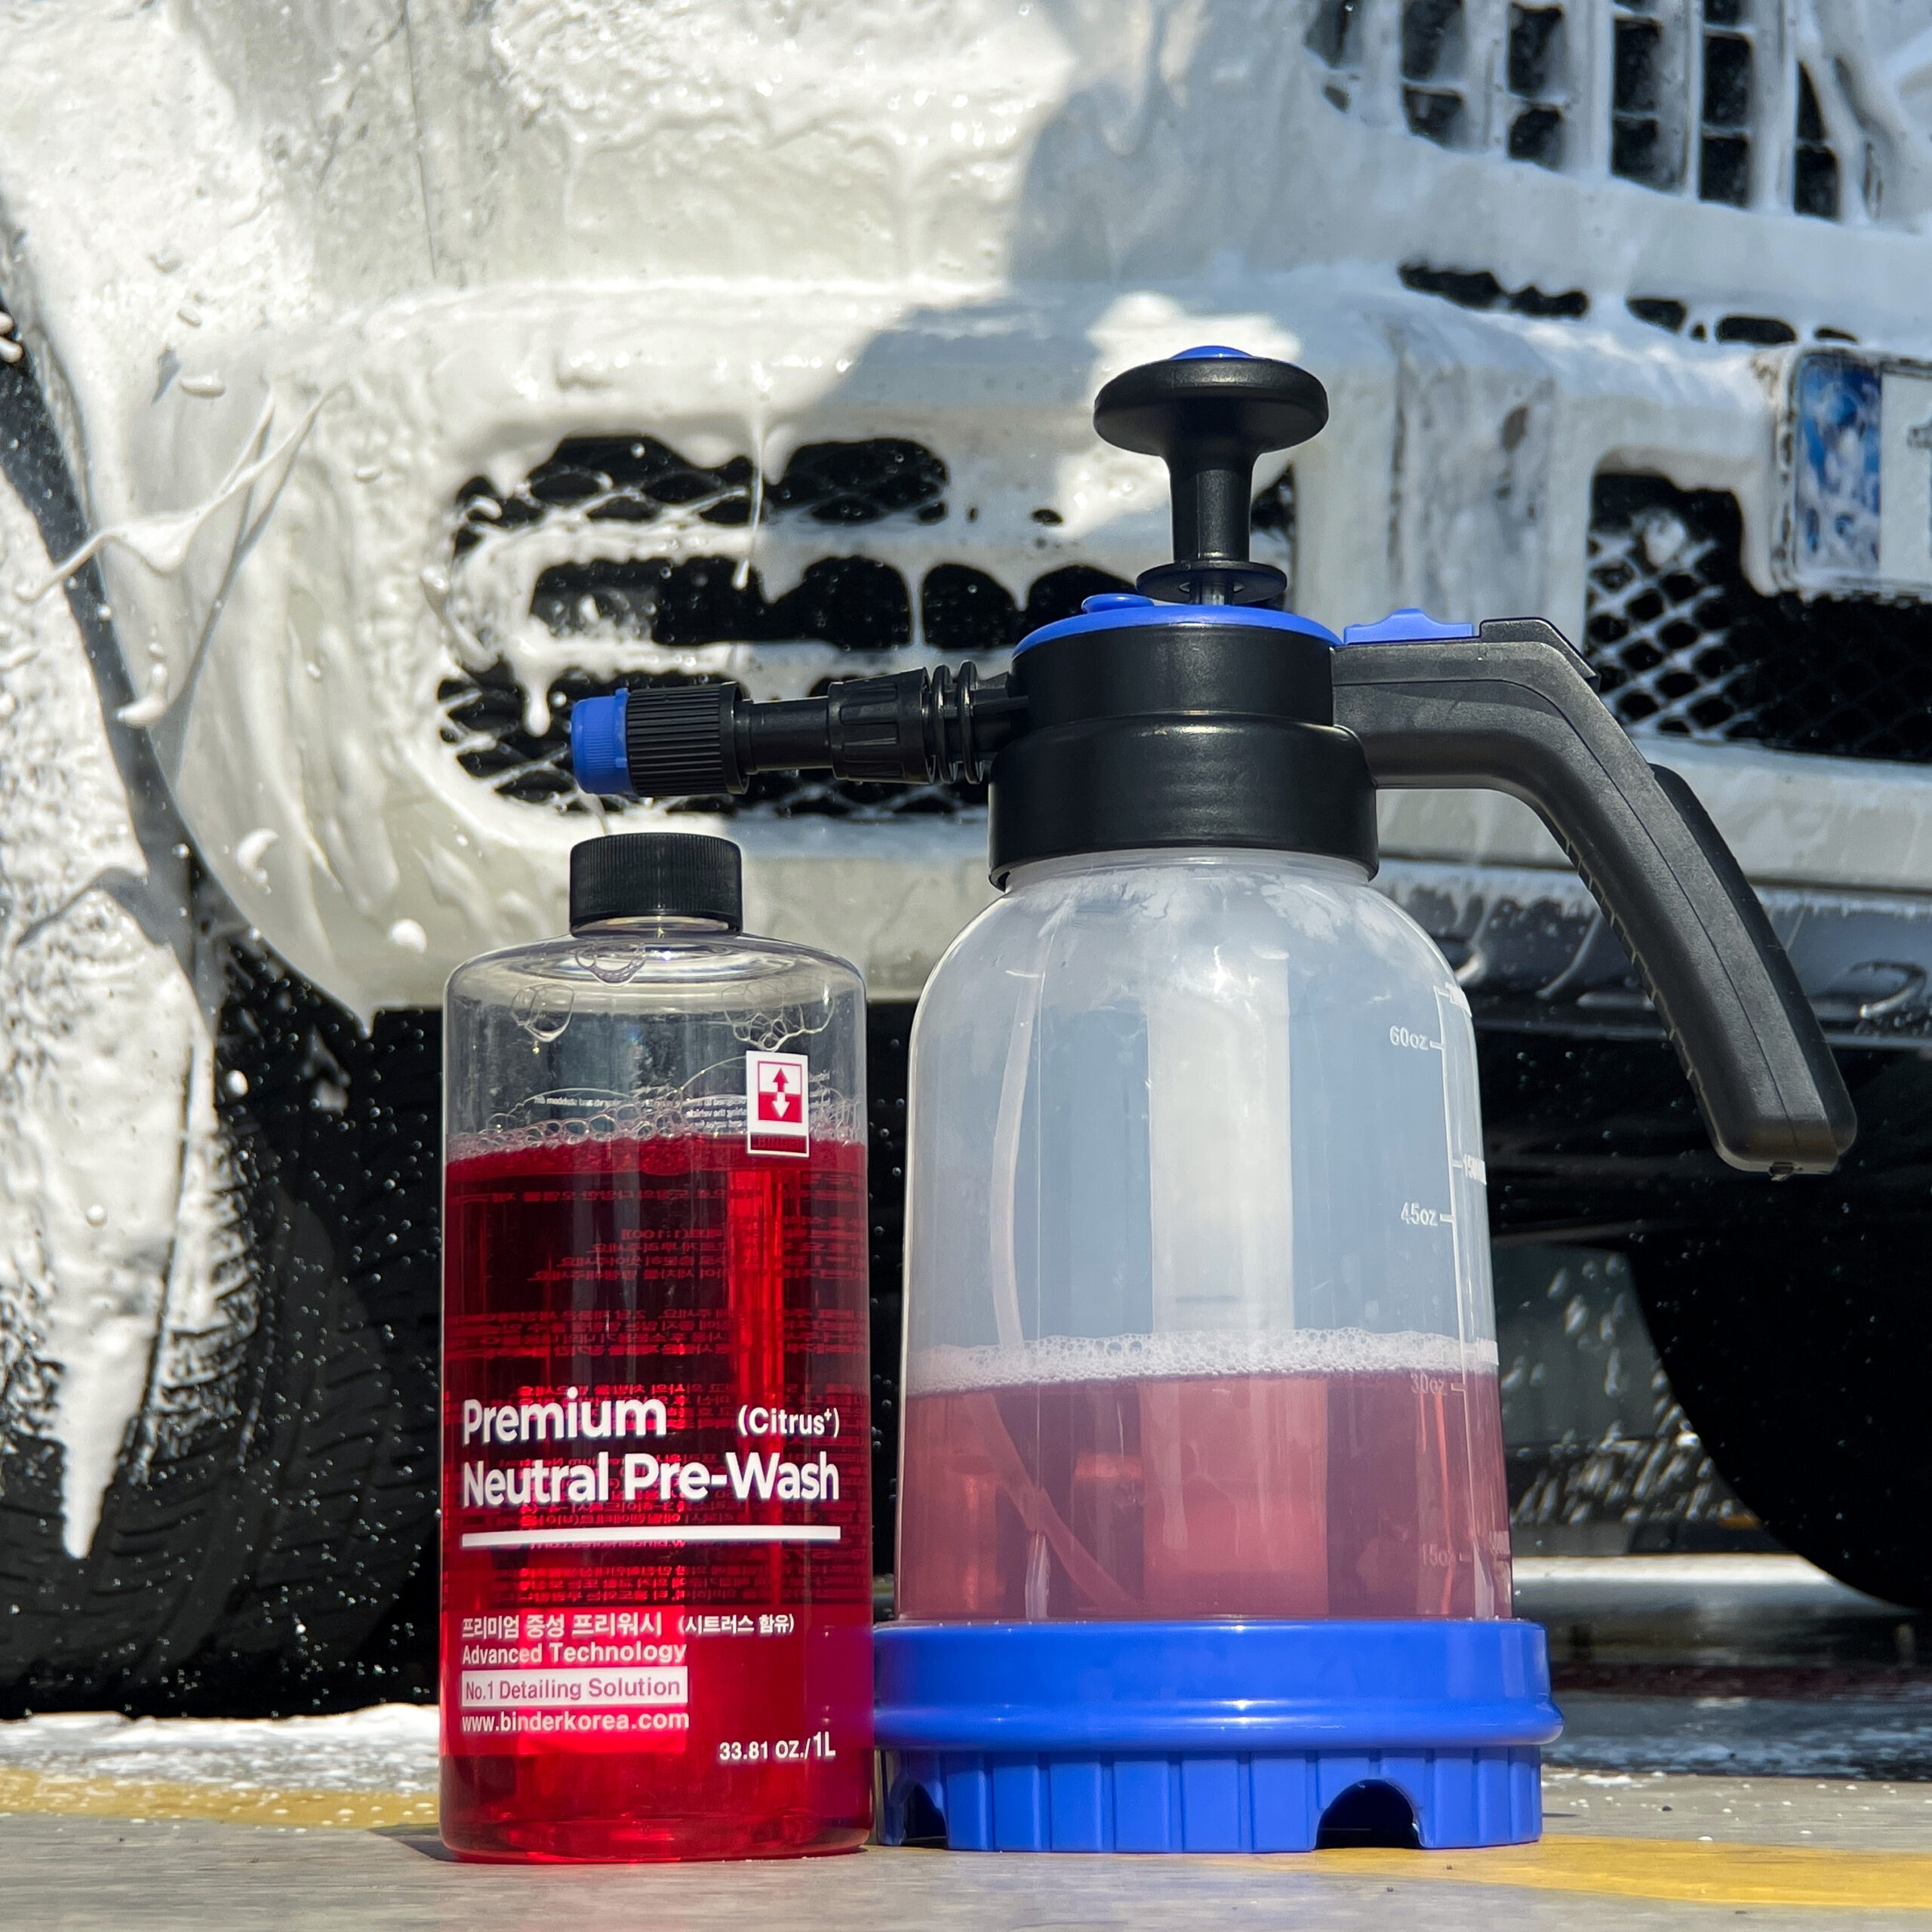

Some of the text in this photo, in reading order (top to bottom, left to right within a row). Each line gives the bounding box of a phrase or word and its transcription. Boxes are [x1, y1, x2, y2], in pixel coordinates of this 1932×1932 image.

[1389, 1025, 1429, 1051] 60oz
[1401, 1201, 1438, 1227] 45oz
[463, 1386, 667, 1446] Premium
[463, 1451, 608, 1508] Neutral
[624, 1451, 839, 1501] Pre-Wash
[462, 1611, 795, 1639] 프리미엄 중성 프리워시 (시트러스 함유)
[462, 1640, 688, 1665] Advanced Technology
[466, 1676, 681, 1701] No.1 Detailing Solution
[462, 1709, 691, 1733] www.binderkorea.com
[719, 1740, 768, 1760] 33.81
